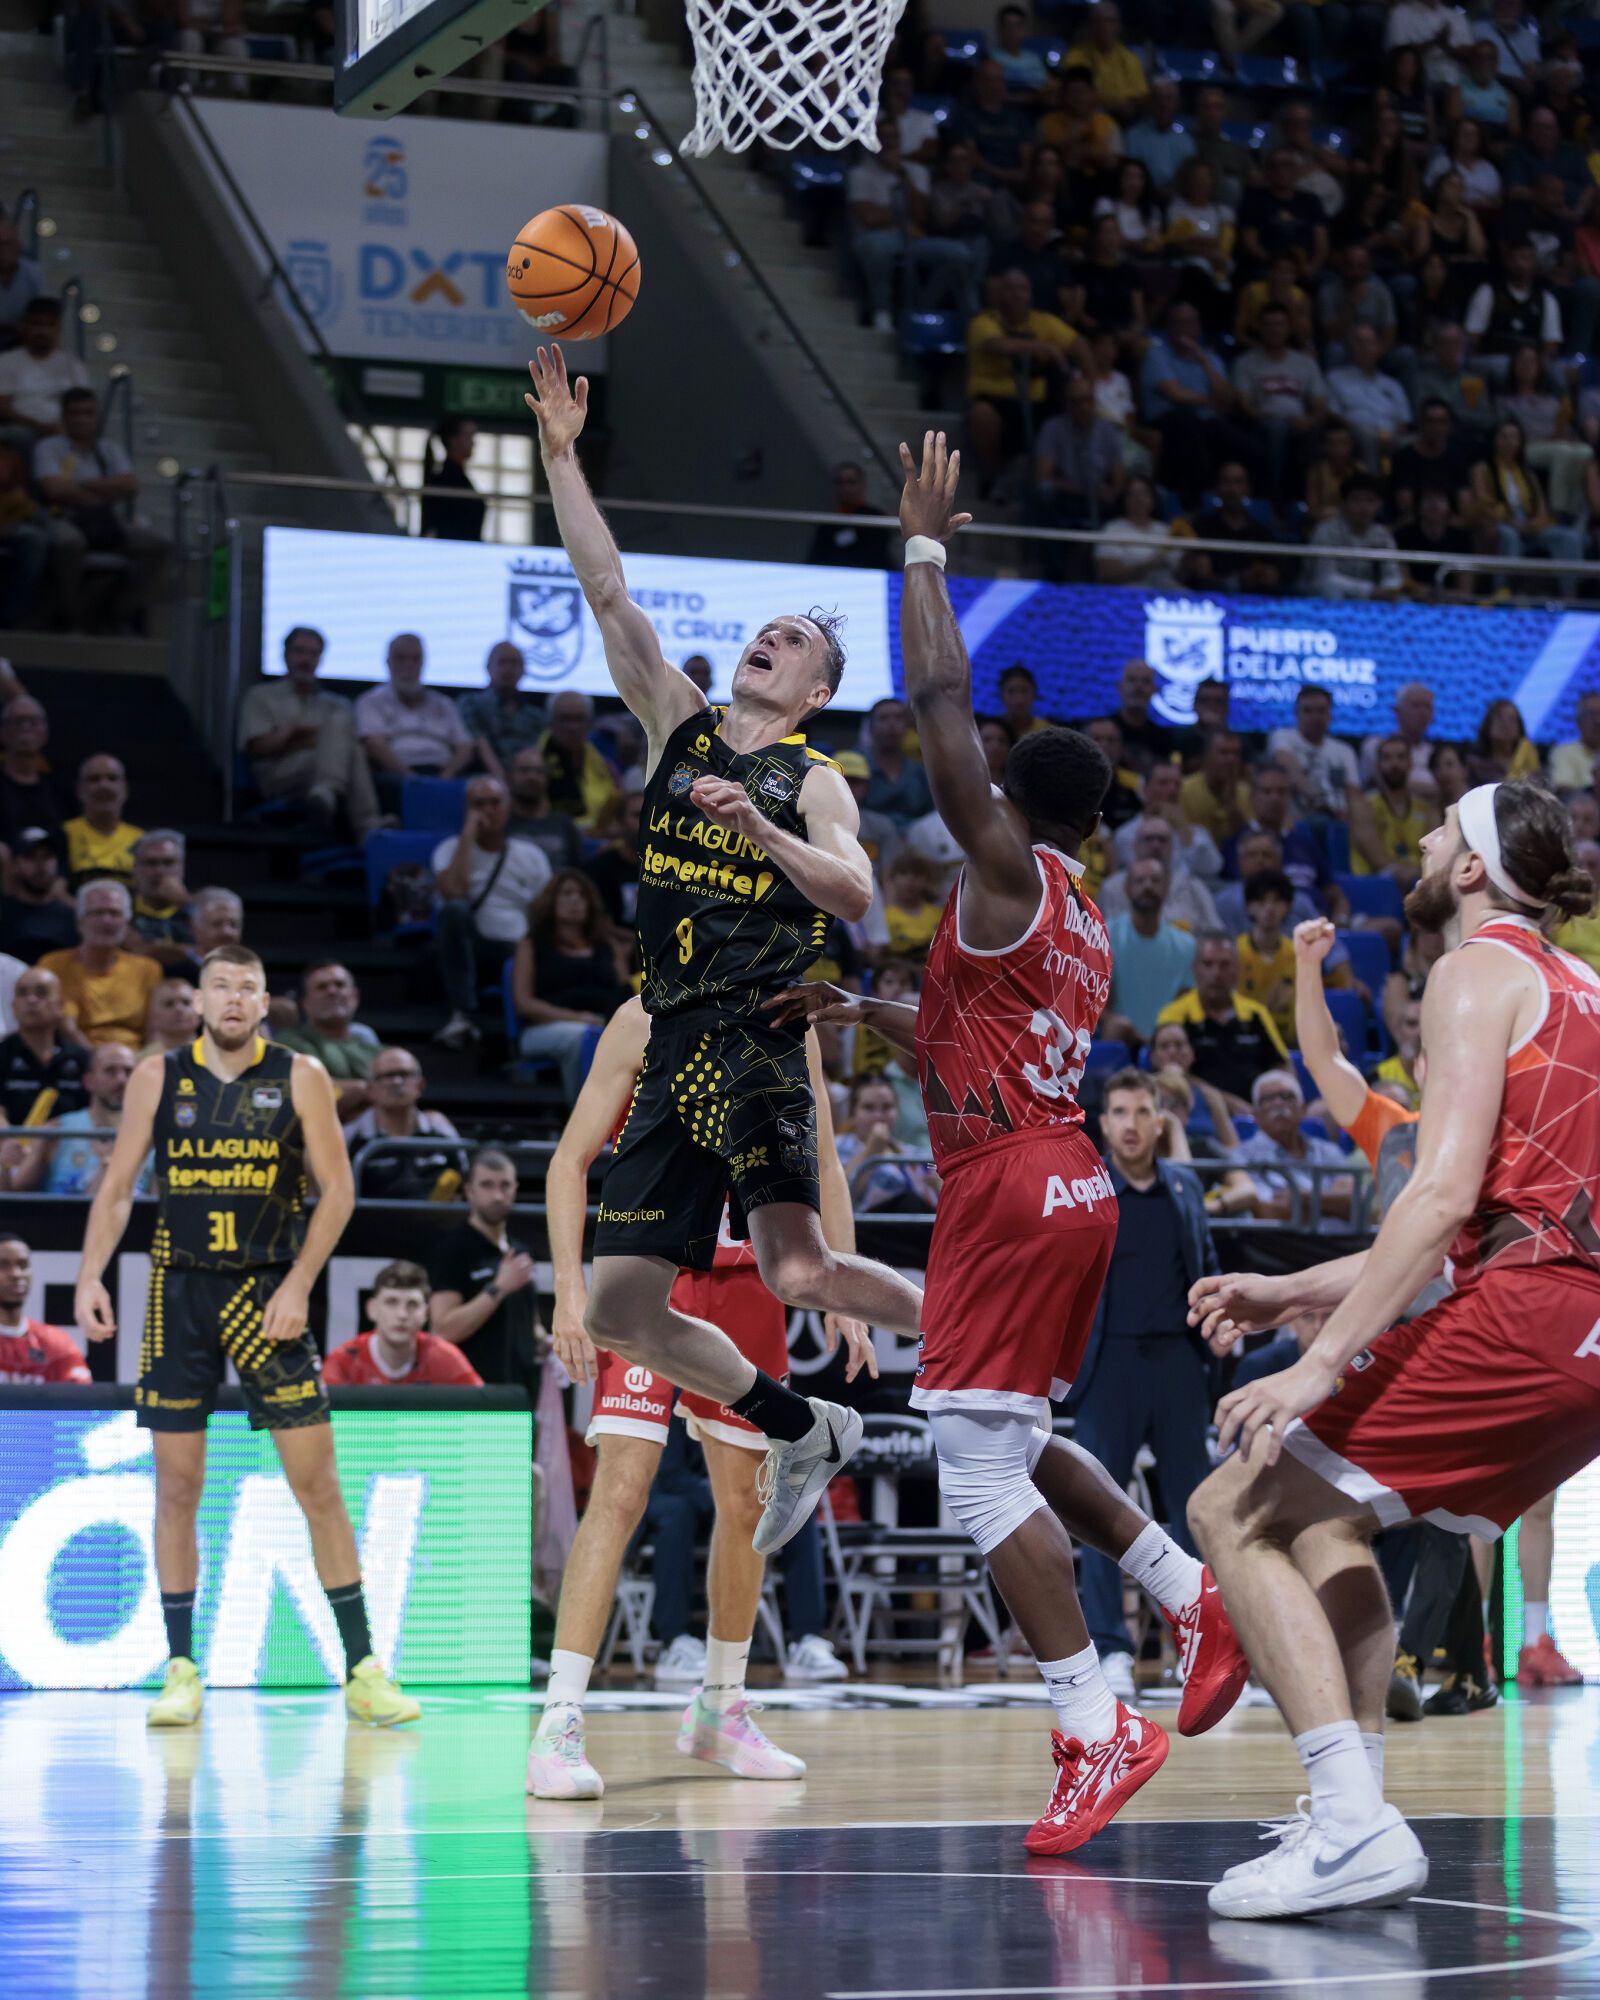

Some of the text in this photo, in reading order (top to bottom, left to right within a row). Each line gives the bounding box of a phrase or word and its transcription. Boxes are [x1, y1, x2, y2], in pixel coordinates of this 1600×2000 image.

[673, 618, 745, 642] CRUZ
[1229, 627, 1337, 656] PUERTO
[1301, 656, 1377, 684] CRUZ
[650, 806, 670, 835] LA
[675, 917, 694, 965] 9
[167, 1139, 280, 1159] LA LAGUNA
[603, 1208, 665, 1224] Hospiten
[208, 1211, 239, 1251] 31
[602, 1394, 666, 1416] unilabor
